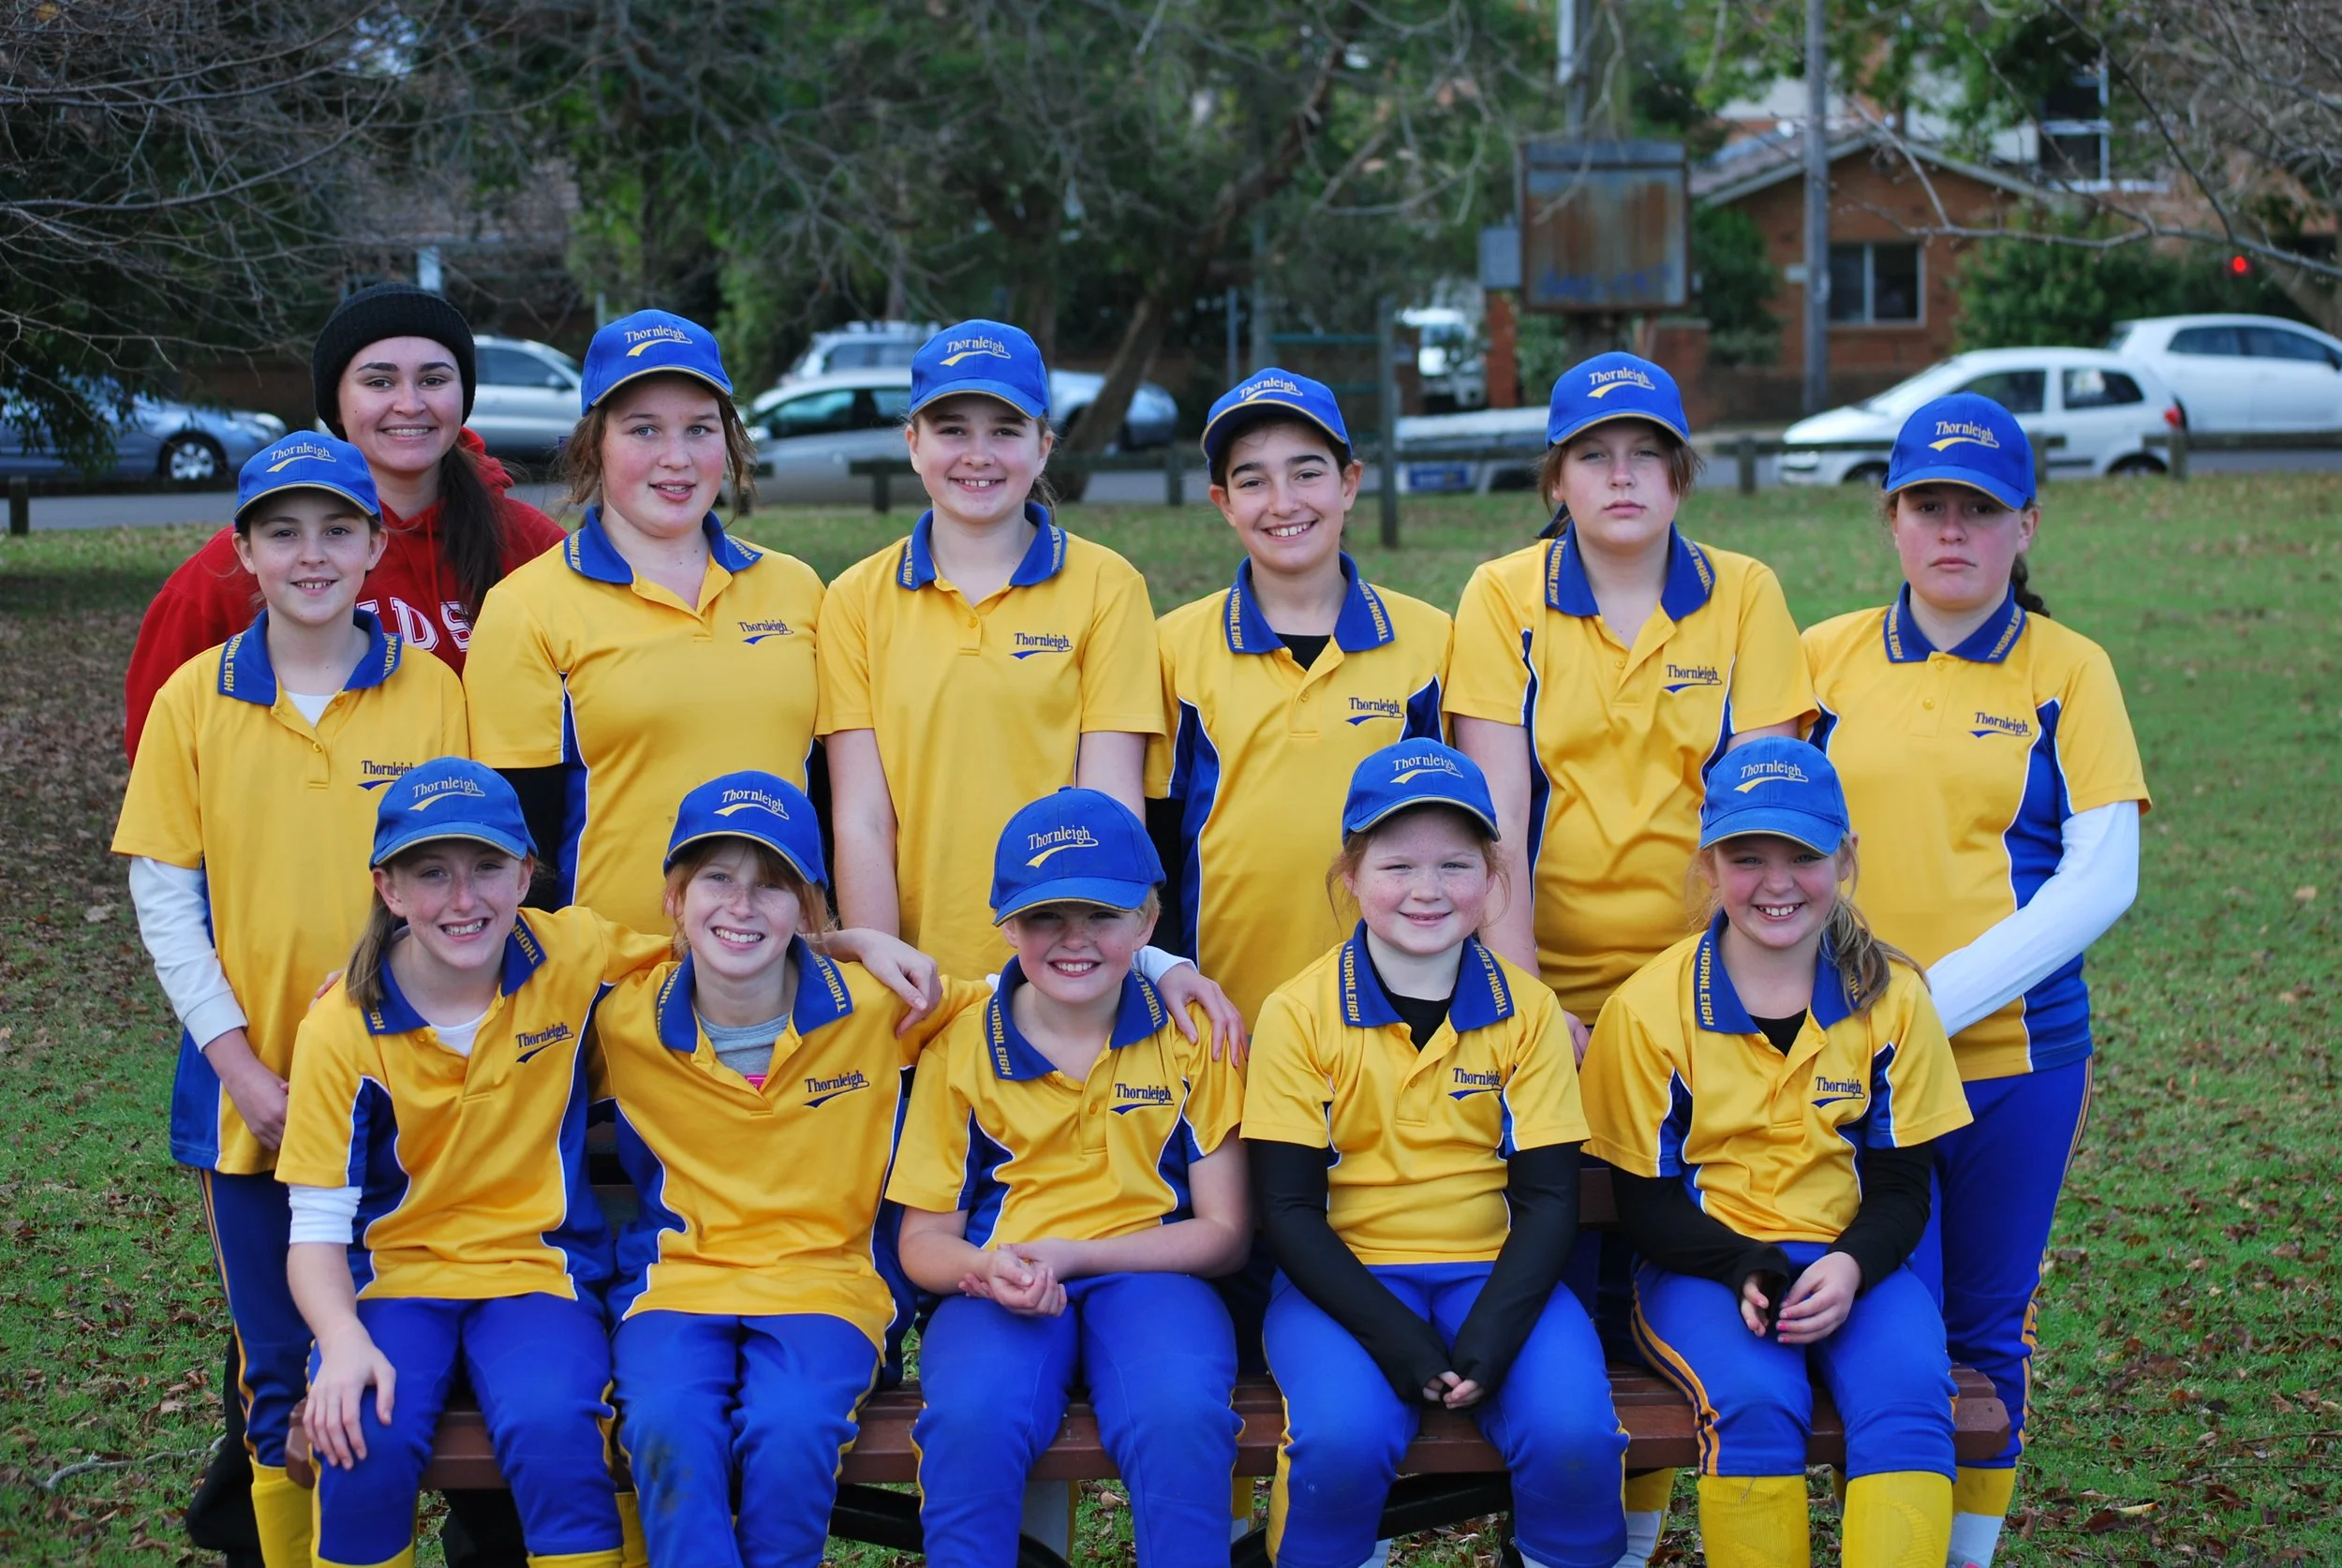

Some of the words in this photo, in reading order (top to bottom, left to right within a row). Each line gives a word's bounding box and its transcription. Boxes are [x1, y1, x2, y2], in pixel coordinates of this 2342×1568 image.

[624, 325, 687, 343] Thornleigh
[946, 336, 1004, 355] Thornleigh
[1587, 367, 1650, 386] Thornleigh
[1239, 377, 1297, 399] Thornleigh
[1935, 421, 1994, 443] Thornleigh
[270, 442, 331, 462] Thornleigh
[738, 620, 789, 635] Thornleigh
[1015, 633, 1070, 653] Thornleigh
[1667, 664, 1719, 685] Thornleigh
[1349, 698, 1401, 717] Thornleigh
[1974, 712, 2028, 736] Thornleigh
[1392, 754, 1458, 773] Thornleigh
[1740, 760, 1802, 779] Thornleigh
[412, 777, 480, 799] Thornleigh
[722, 790, 785, 813] Thornleigh
[1028, 825, 1091, 851] Thornleigh
[516, 1023, 570, 1049] Thornleigh
[805, 1071, 866, 1094] Thornleigh
[1115, 1084, 1173, 1106] Thornleigh
